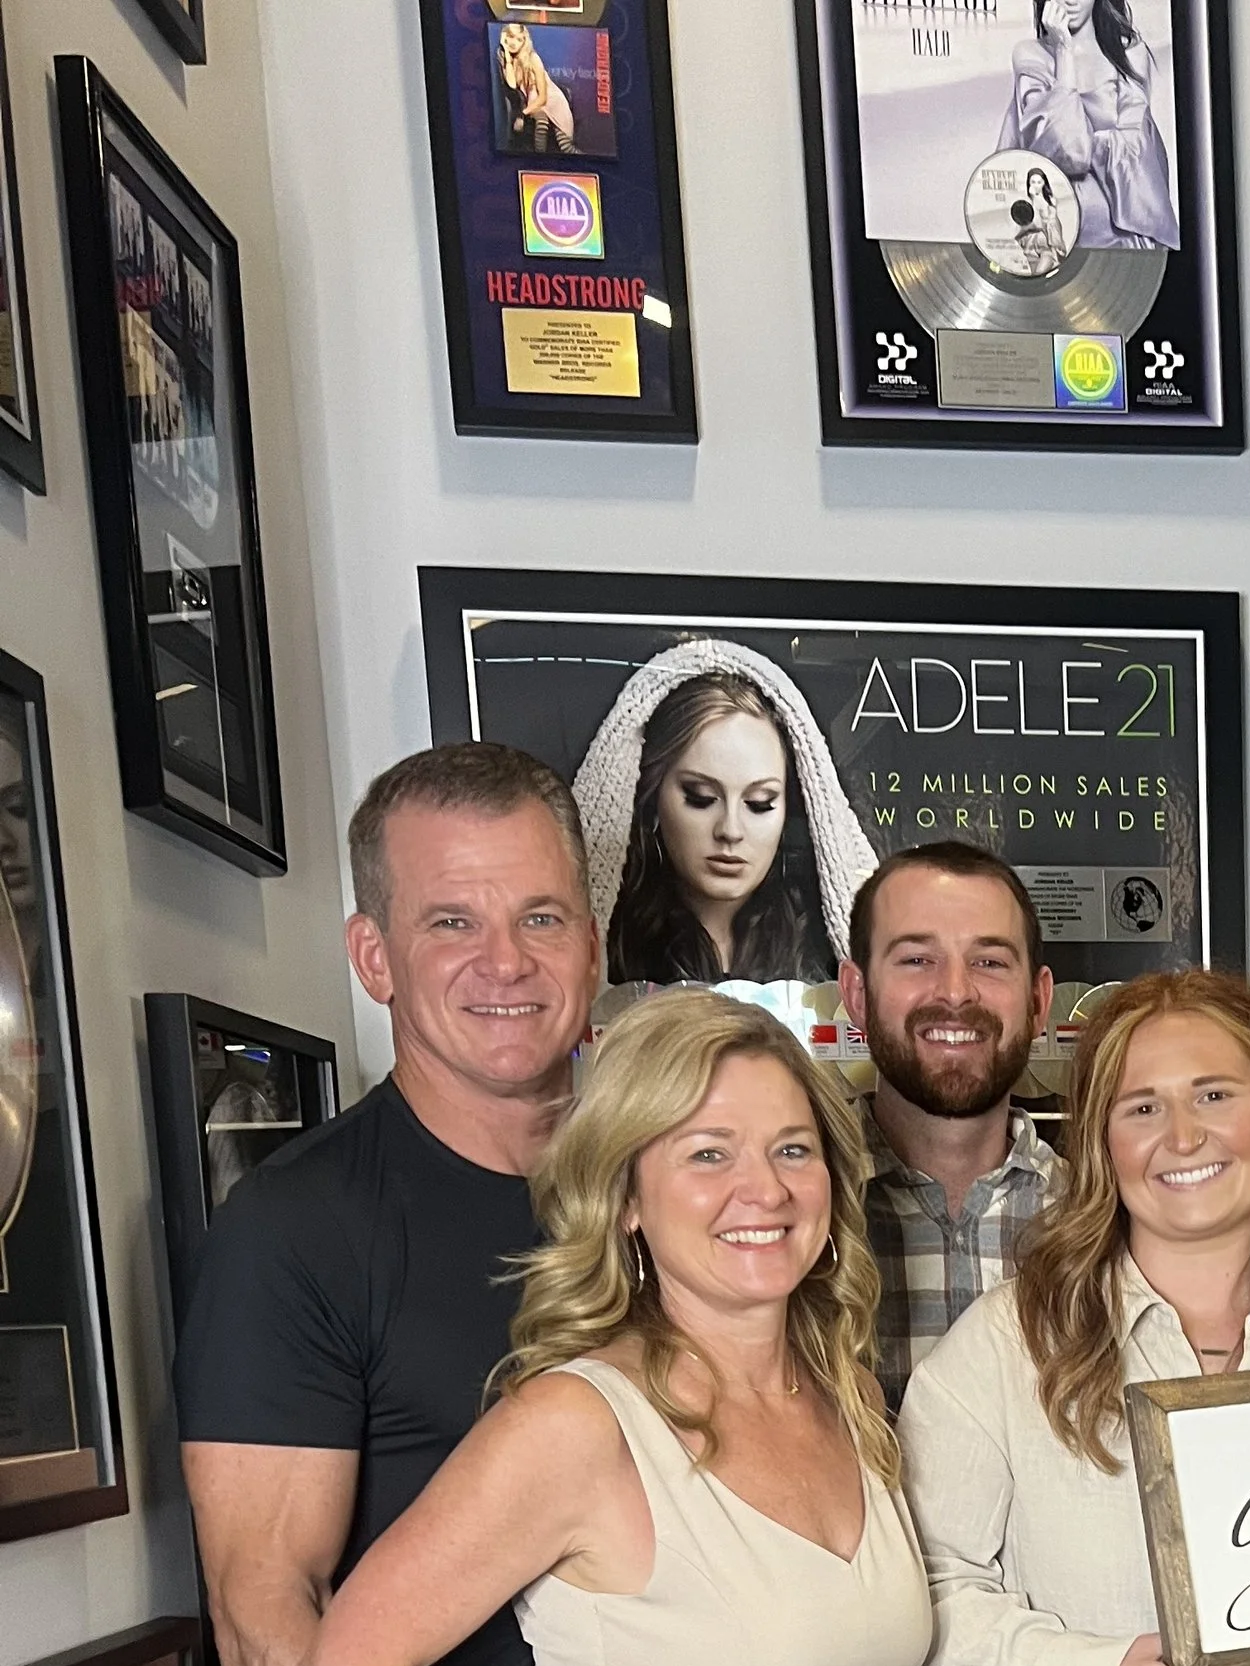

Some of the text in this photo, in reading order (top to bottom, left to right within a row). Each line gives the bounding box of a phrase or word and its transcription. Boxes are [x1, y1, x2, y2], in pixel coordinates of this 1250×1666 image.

[547, 196, 578, 216] RIAA
[487, 271, 646, 309] HEADSTRONG
[1076, 352, 1104, 372] RIAA
[851, 656, 1174, 737] ADELE 21
[869, 771, 1168, 797] 12 MILLION SALES
[874, 806, 1166, 831] WORLDWIDE
